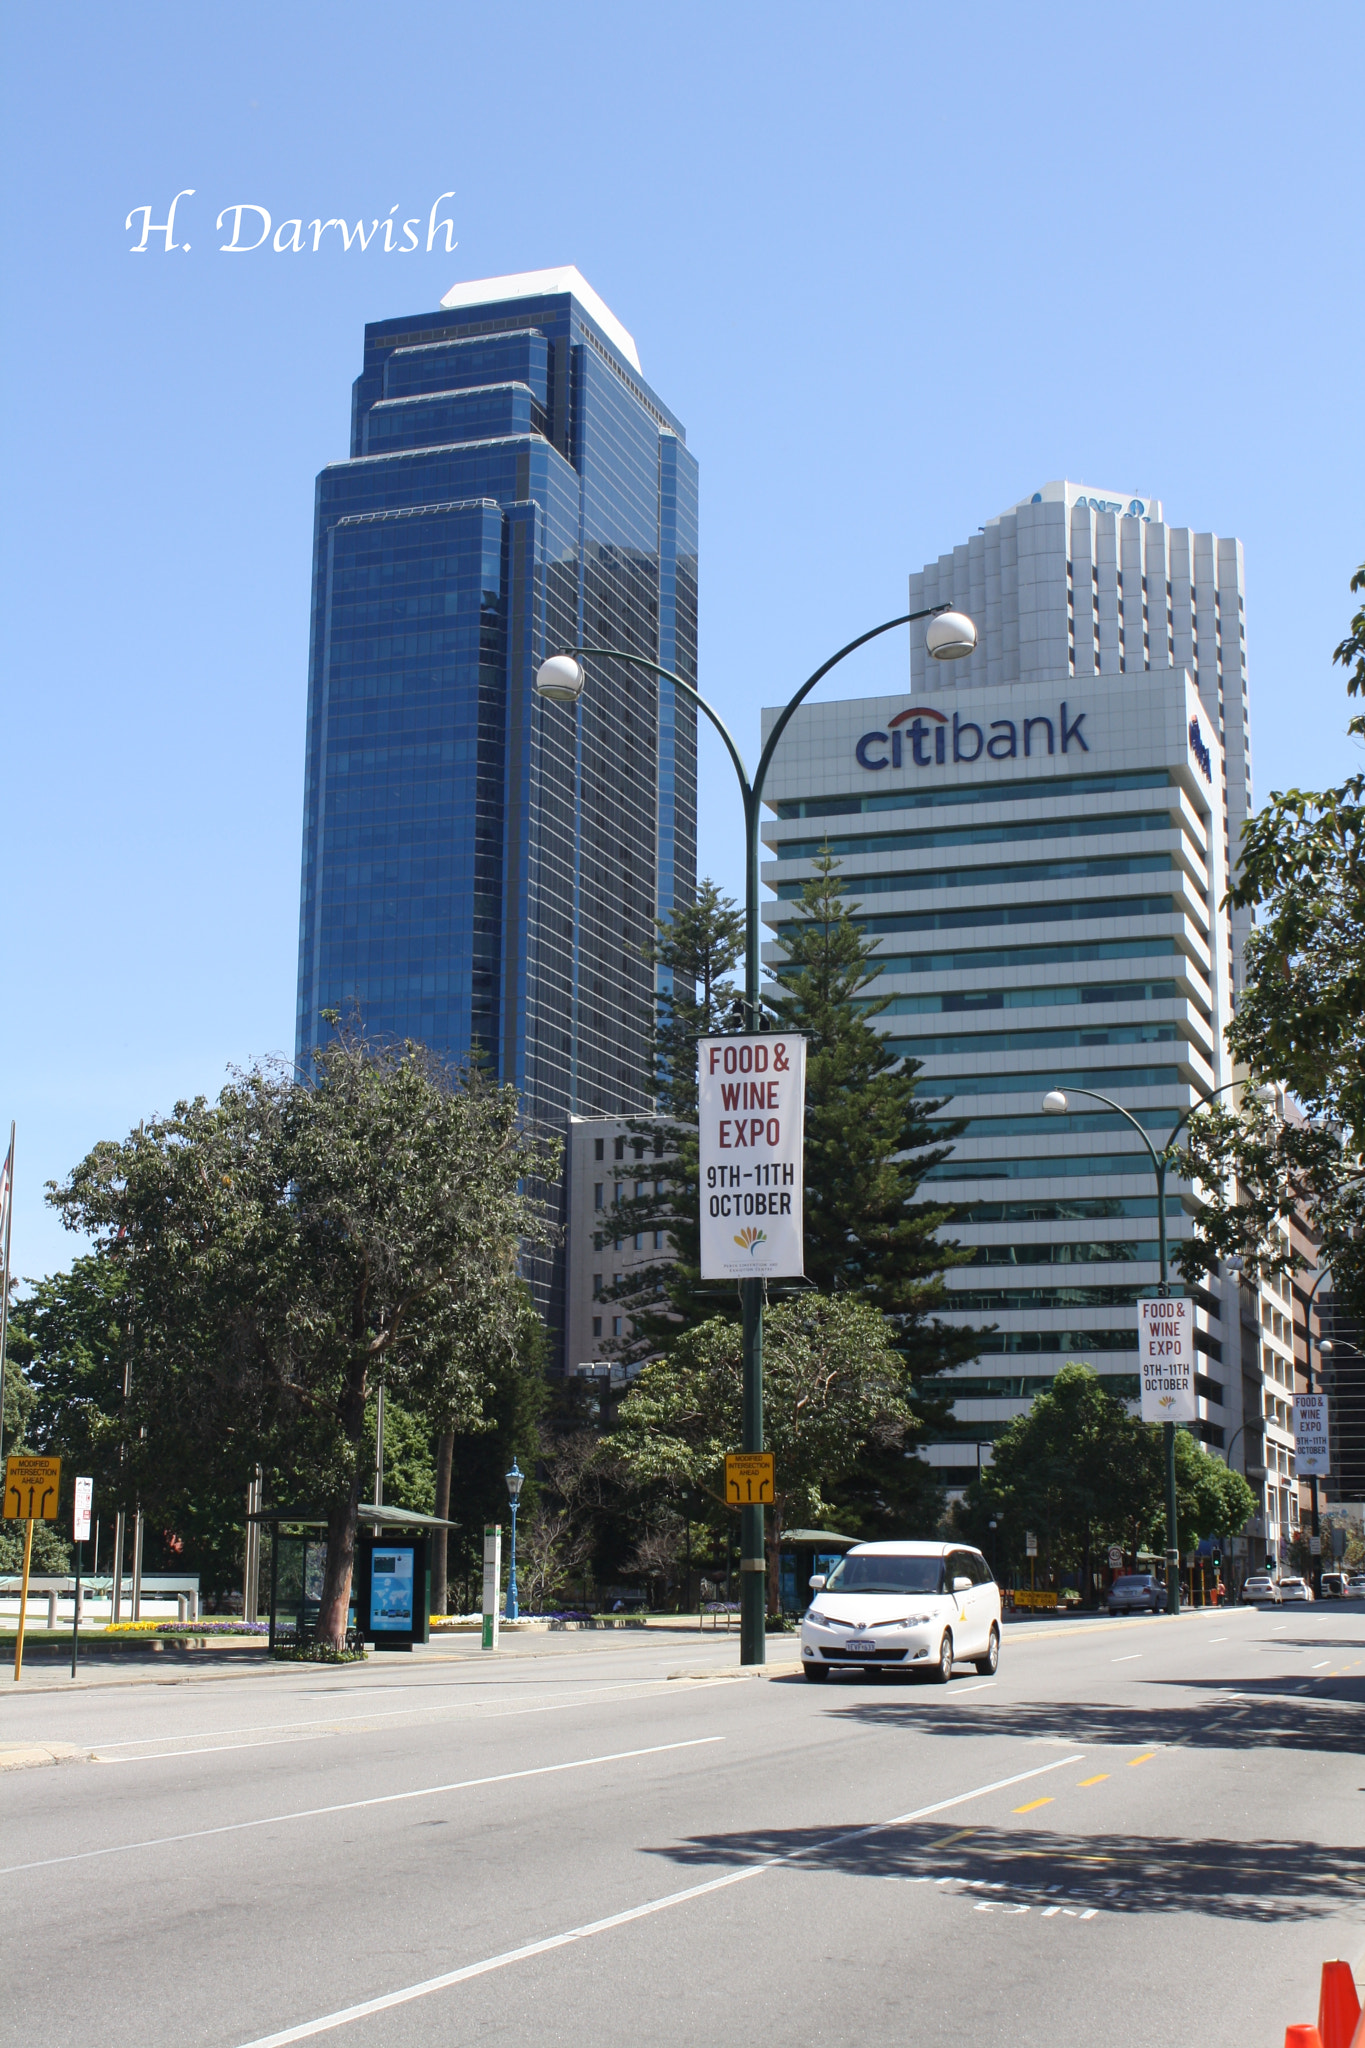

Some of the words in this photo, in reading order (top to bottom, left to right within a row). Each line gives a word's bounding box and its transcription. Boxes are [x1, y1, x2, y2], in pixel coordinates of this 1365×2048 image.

[855, 702, 1089, 770] citibank
[709, 1044, 768, 1075] FOOD
[773, 1042, 790, 1072] &
[720, 1081, 779, 1111] WINE
[719, 1118, 780, 1148] EXPO
[707, 1163, 794, 1188] 9TH-11TH
[709, 1192, 791, 1217] OCTOBER
[1143, 1303, 1174, 1318] FOOD
[1176, 1302, 1186, 1317] &
[1149, 1322, 1181, 1337] WINE
[1149, 1341, 1182, 1356] EXPO
[1143, 1364, 1190, 1377] 9TH-11TH
[1145, 1379, 1189, 1391] OCTOBER
[1296, 1397, 1317, 1407] FOOD
[1300, 1409, 1321, 1419] WINE
[1300, 1422, 1322, 1432] EXPO
[1298, 1446, 1326, 1454] OCTOBER
[18, 1460, 50, 1468] MODIFIED
[10, 1468, 57, 1476] INTERSECTION
